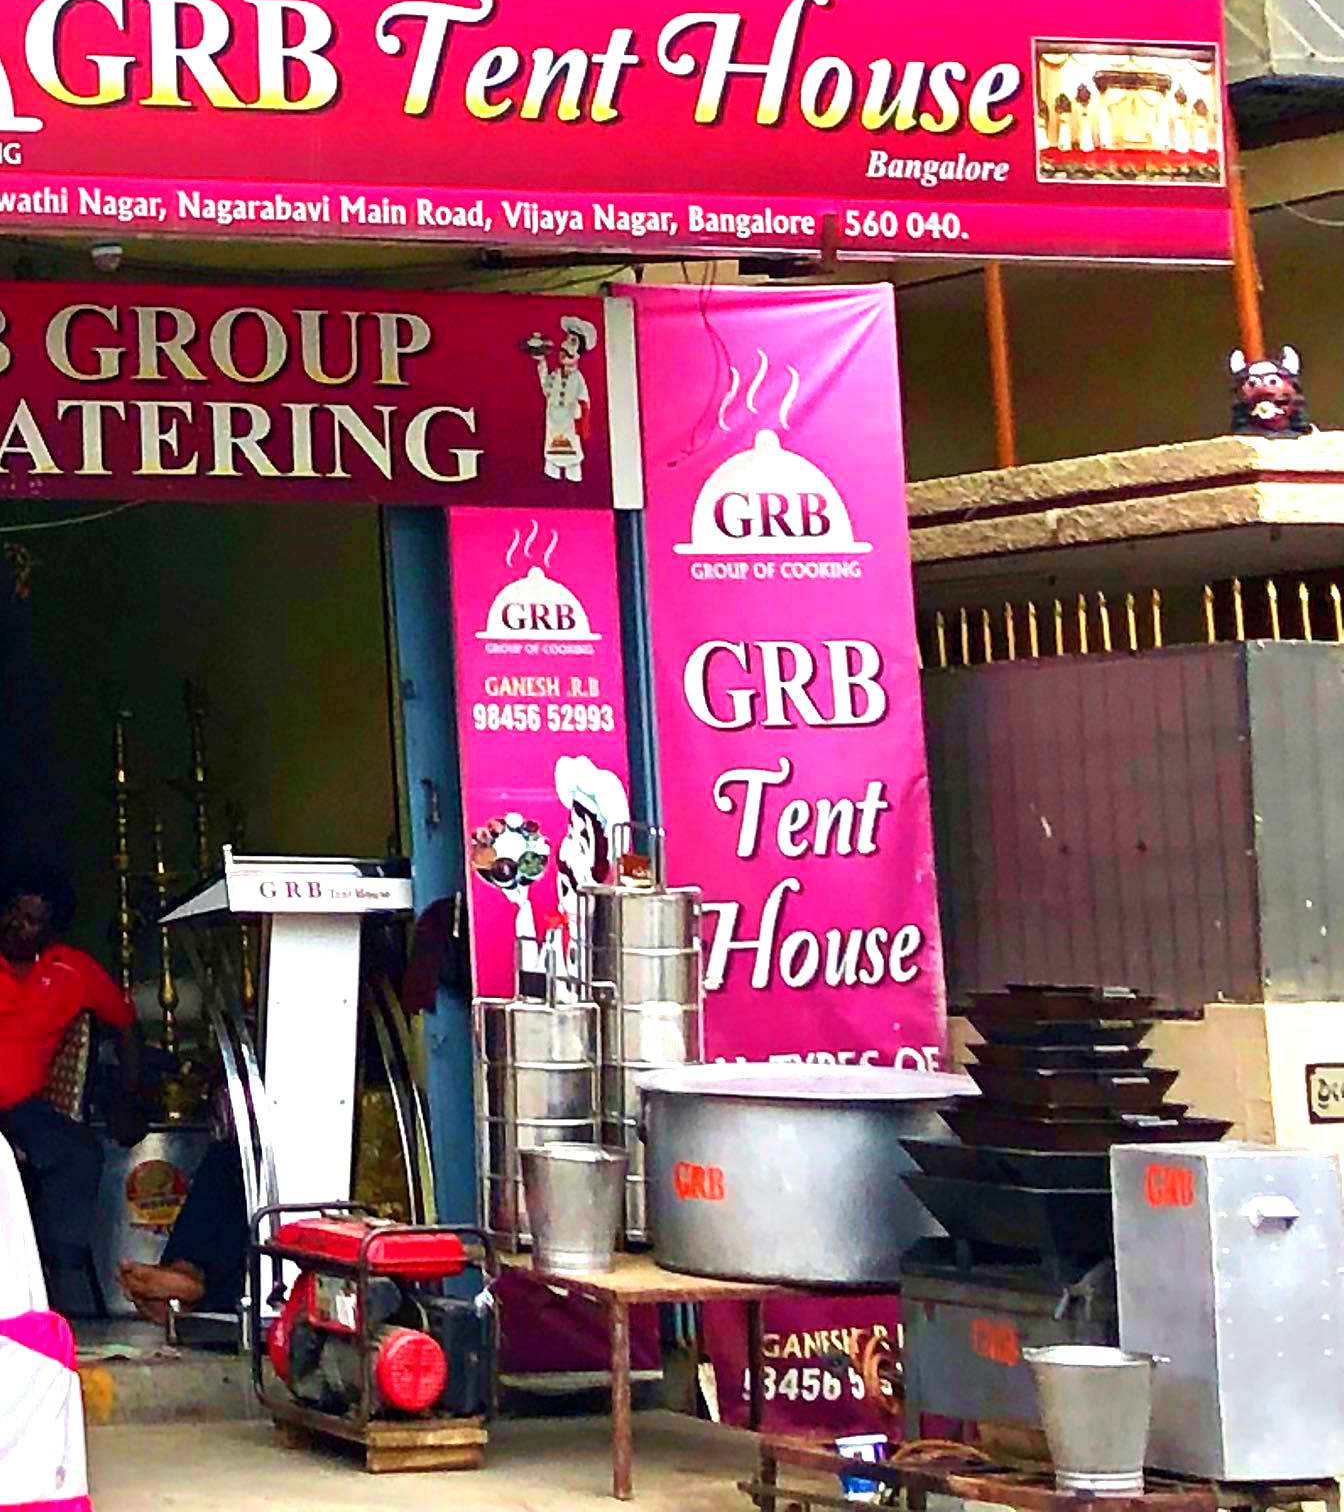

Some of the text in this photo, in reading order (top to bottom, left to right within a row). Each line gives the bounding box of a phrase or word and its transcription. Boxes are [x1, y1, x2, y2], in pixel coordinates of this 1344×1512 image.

[865, 150, 1010, 187] Bangalore
[78, 188, 167, 222] Nagar,
[177, 191, 331, 225] Nagarabavi
[340, 195, 407, 225] Main
[416, 198, 492, 230] Road,
[500, 199, 583, 236] Vijaya
[592, 202, 678, 238] Nagar,
[688, 205, 815, 240] Bangalore
[844, 211, 899, 238] 560
[906, 213, 969, 240] 040.
[45, 304, 431, 385] GROUP
[714, 491, 831, 539] GRB
[690, 561, 861, 580] GROUP OF COOKING
[501, 602, 576, 631] GRB
[484, 676, 560, 697] GANESH
[683, 639, 887, 730] GRB
[473, 703, 614, 732] 98456 52993
[714, 758, 888, 858] Tent
[702, 878, 922, 990] House
